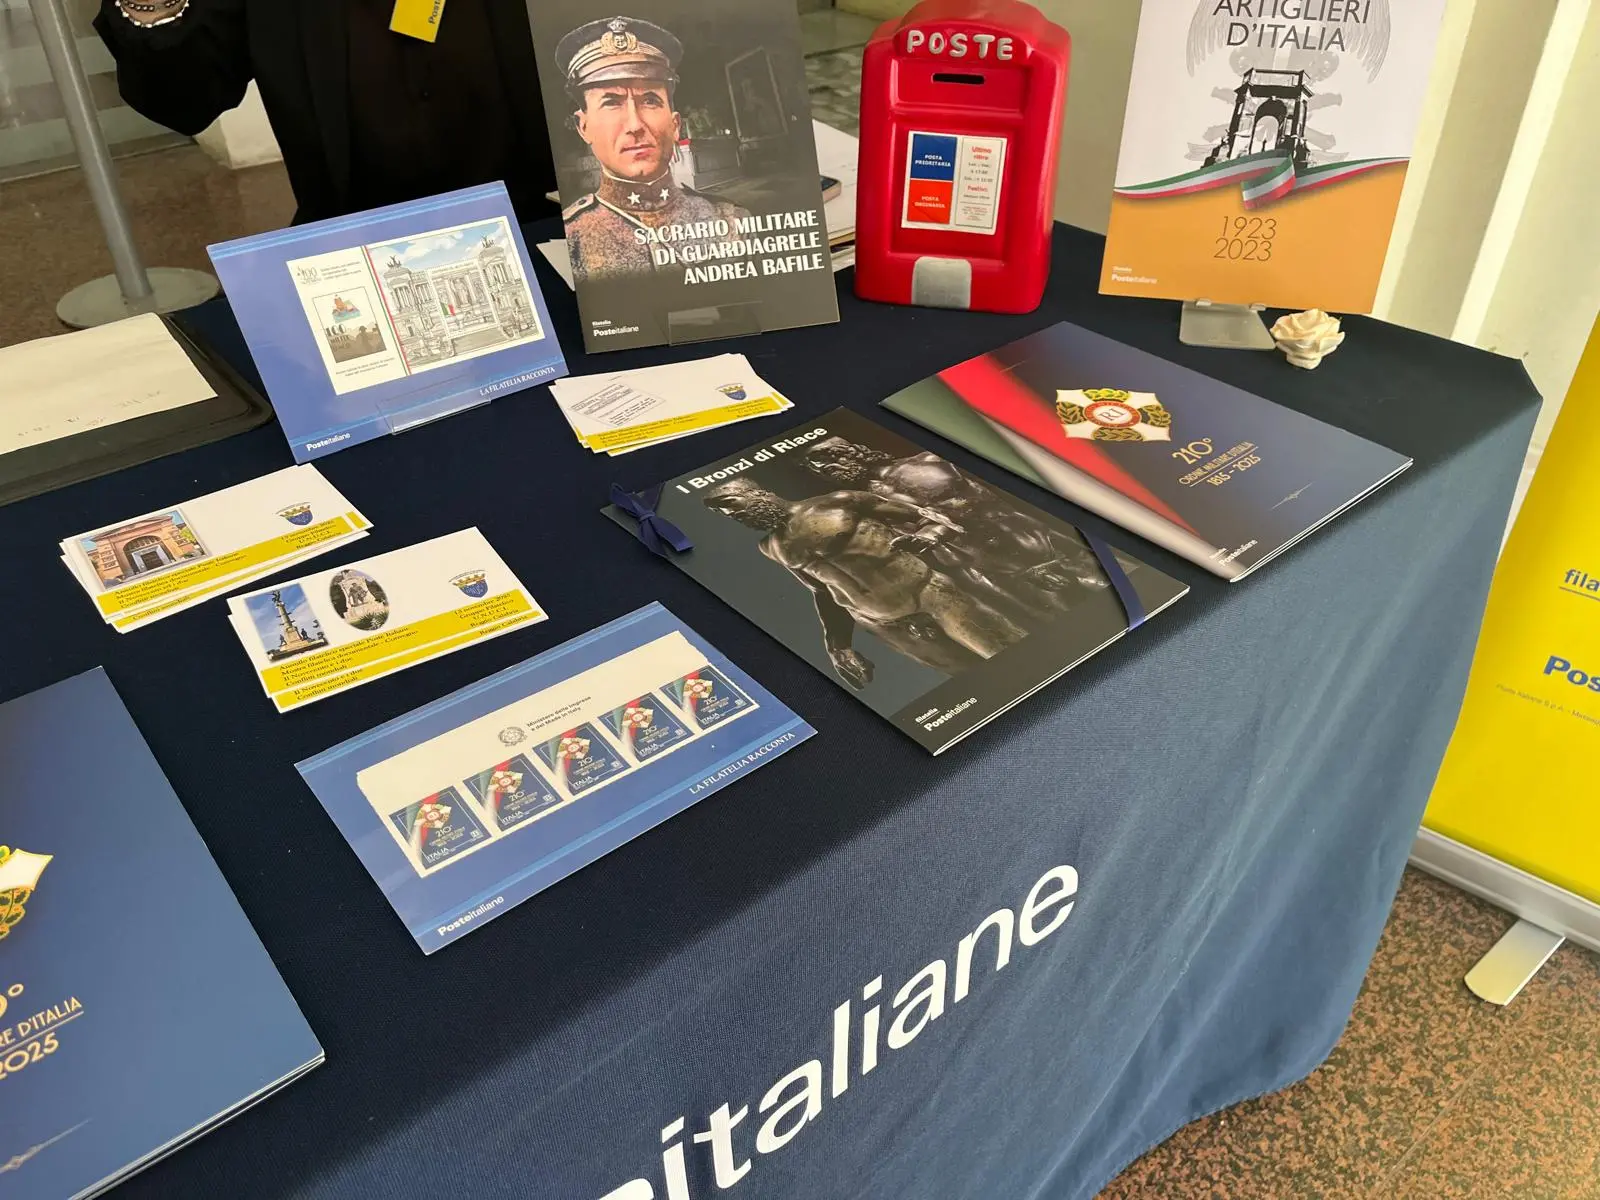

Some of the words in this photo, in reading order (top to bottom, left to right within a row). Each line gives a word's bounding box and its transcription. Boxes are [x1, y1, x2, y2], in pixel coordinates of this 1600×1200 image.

[1213, 0, 1371, 24] ARTIGLIERI
[906, 29, 1013, 61] POSTE
[1226, 22, 1346, 52] D'ITALIA
[914, 159, 952, 168] PRIORITARIA
[633, 219, 730, 246] SACRARIO
[733, 209, 820, 235] MILITARE
[1220, 215, 1278, 240] 1923
[656, 248, 678, 266] DI
[681, 231, 823, 263] GUARDIAGRELE
[1213, 238, 1272, 262] 2023
[683, 261, 758, 285] ANDREA
[762, 252, 825, 276] BAFILE
[593, 326, 639, 336] Posteitaliane
[489, 377, 522, 393] FILATELIA
[521, 366, 556, 383] RACCONTA
[306, 431, 352, 452] Posteitaliane
[1172, 437, 1213, 464] 210°
[675, 484, 691, 494] I
[687, 457, 755, 489] Bronzi
[753, 447, 776, 462] di
[771, 427, 828, 454] Riace
[1207, 472, 1231, 486] 1815
[1233, 454, 1262, 472] 2025
[281, 665, 306, 676] Mostra
[1543, 655, 1600, 693] Pos
[526, 713, 555, 728] Ministero
[554, 706, 568, 715] delle
[568, 696, 592, 708] Imprese
[545, 715, 561, 725] Made
[567, 706, 581, 716] Italy
[923, 697, 978, 731] Posteitaliane
[689, 783, 706, 794] LA
[704, 759, 750, 787] FILATELIA
[747, 732, 796, 762] RACCONTA
[427, 847, 450, 862] ITALIA
[437, 895, 505, 938] Posteitaliane
[17, 996, 83, 1037] D'ITALIA
